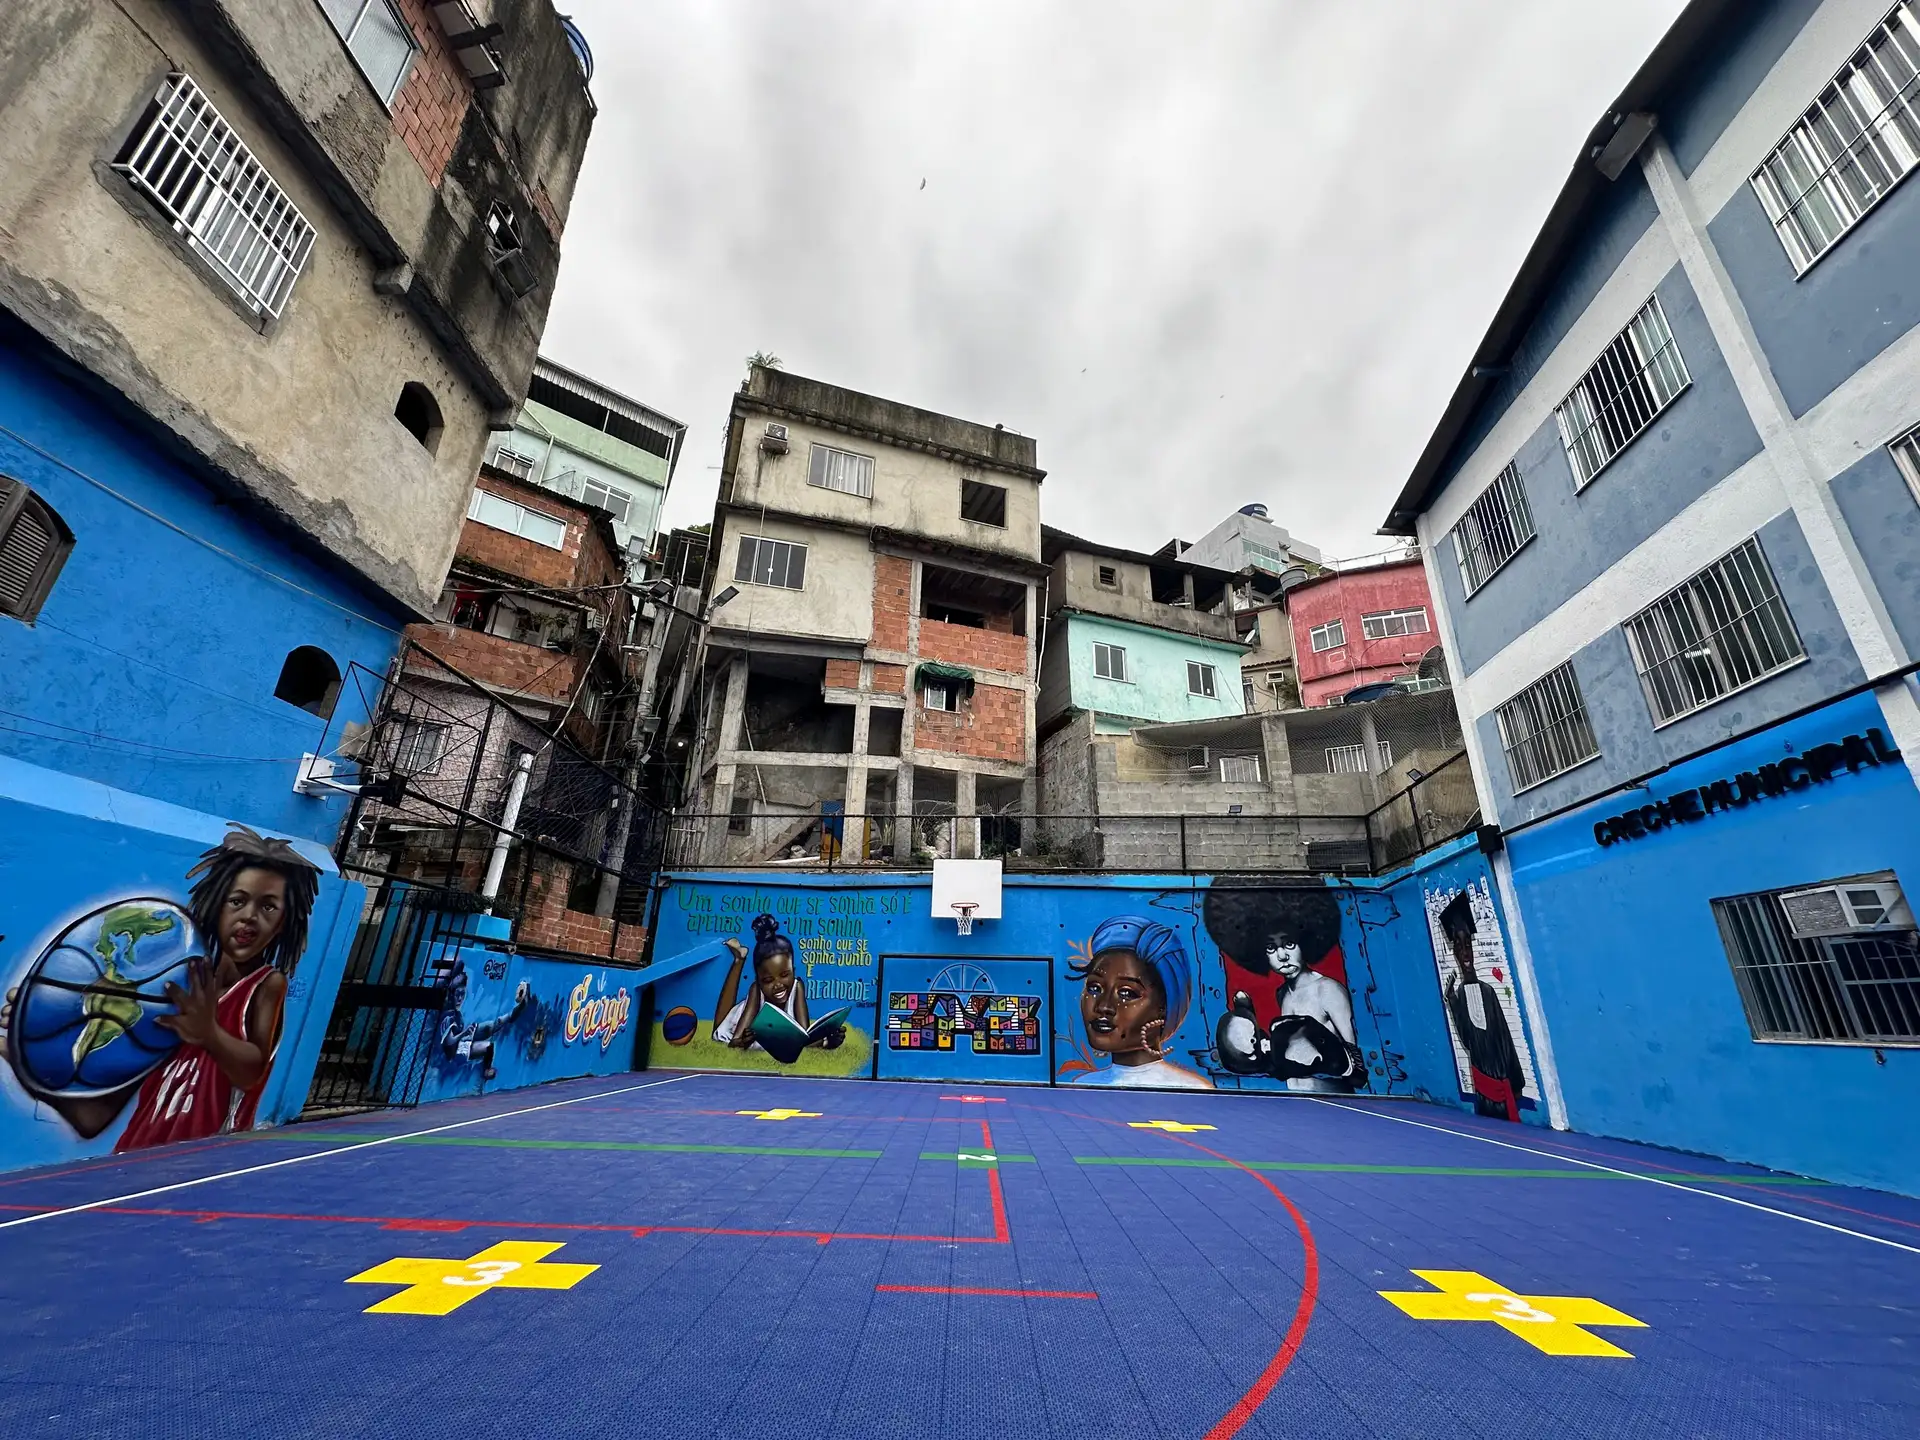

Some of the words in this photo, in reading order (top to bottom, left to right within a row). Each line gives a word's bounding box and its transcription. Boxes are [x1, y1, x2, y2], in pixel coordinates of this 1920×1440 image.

[1593, 788, 1706, 847] CRECHE
[1699, 727, 1902, 815] MUNICIPAL
[442, 1260, 522, 1286] 3
[1465, 1292, 1556, 1323] 3
